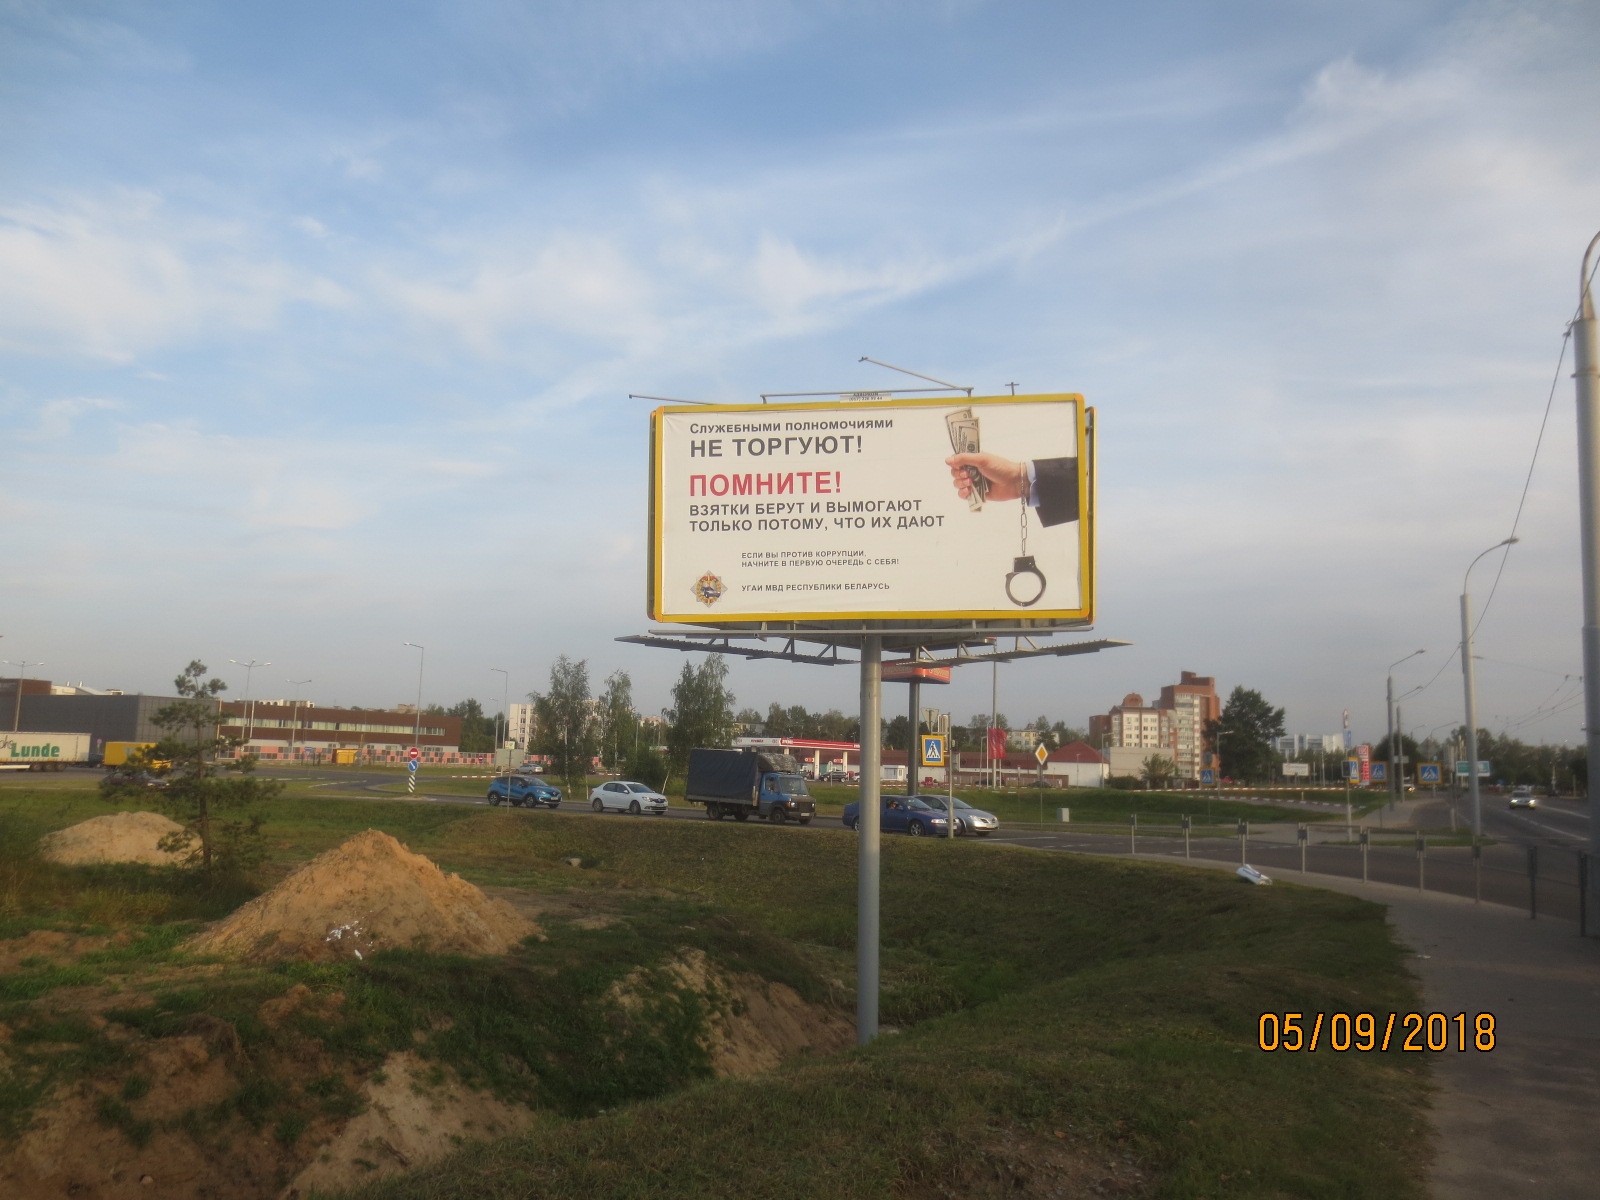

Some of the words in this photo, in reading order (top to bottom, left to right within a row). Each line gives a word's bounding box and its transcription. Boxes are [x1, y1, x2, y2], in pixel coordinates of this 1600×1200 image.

[690, 439, 723, 458] НЕ
[731, 434, 862, 457] ТОРГУЮТ!
[689, 470, 841, 497] ПОМНИТЕ!
[689, 503, 750, 517] ВЗЯТКИ
[755, 502, 805, 515] БЕРУТ
[810, 501, 820, 514] И
[826, 499, 923, 513] ВЫМОГАЮТ
[689, 519, 753, 533] ТОЛЬКО
[833, 516, 866, 529] ЧТО
[871, 516, 892, 529] ИХ
[896, 515, 945, 530] ДАЮТ
[741, 560, 779, 568] НАЧНИТЕ
[789, 559, 824, 567] ПЕРВУЮ
[825, 558, 864, 567] ОЧЕРЕДЬ
[874, 558, 899, 566] СЕБЯ!
[741, 584, 763, 592] УГАИ
[765, 584, 784, 593] МВД
[785, 583, 842, 591] РЕСПУБЛИКИ
[844, 582, 890, 591] БЕЛАРУСЬ
[10, 742, 60, 758] Lunde
